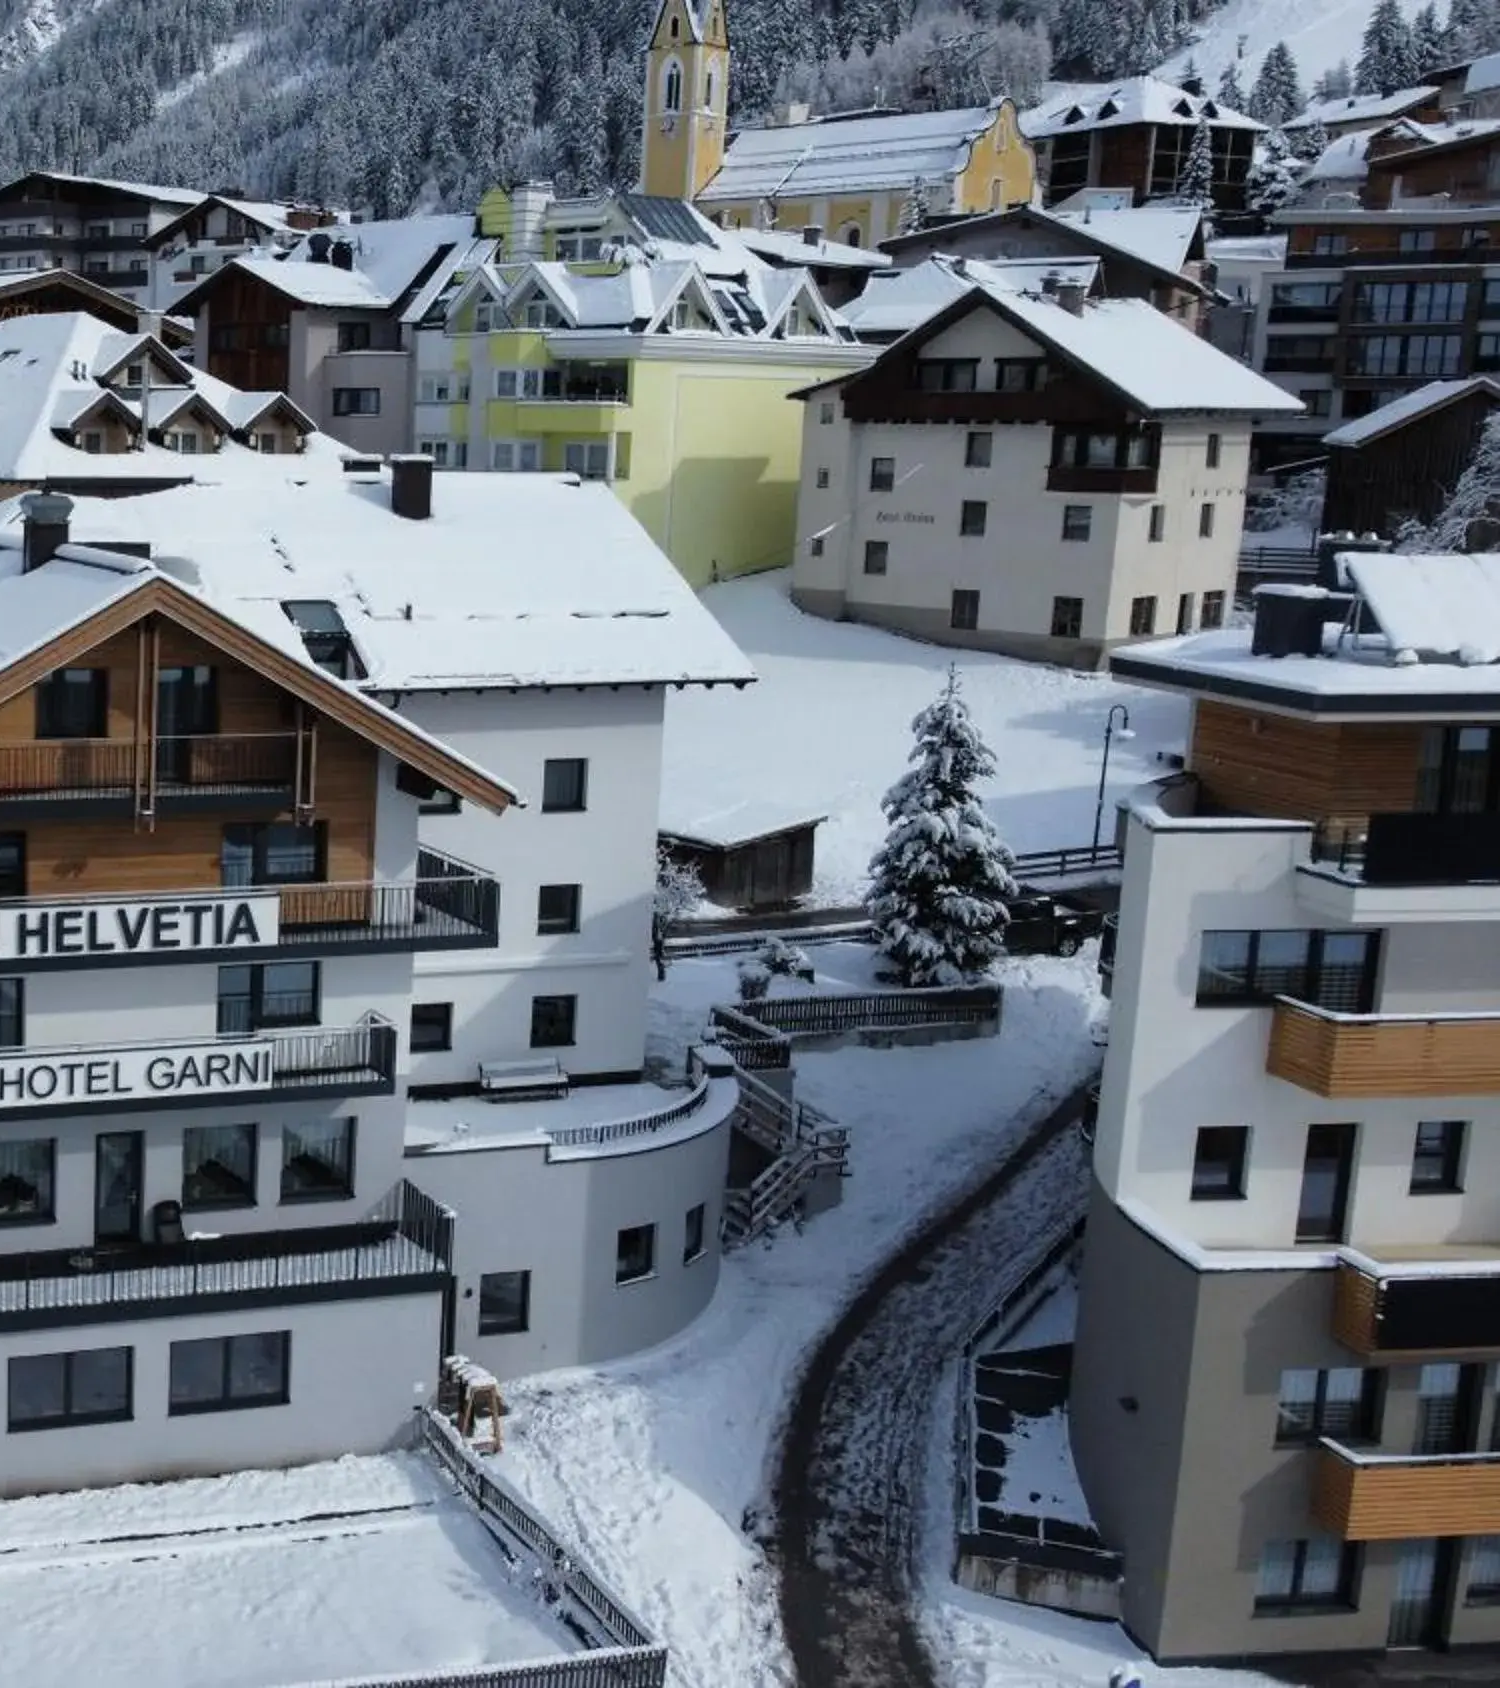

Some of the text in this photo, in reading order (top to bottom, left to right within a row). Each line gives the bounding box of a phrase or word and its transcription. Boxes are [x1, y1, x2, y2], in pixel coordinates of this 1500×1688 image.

[18, 902, 260, 955] HELVETIA
[0, 1050, 271, 1101] HOTEL GARNI
